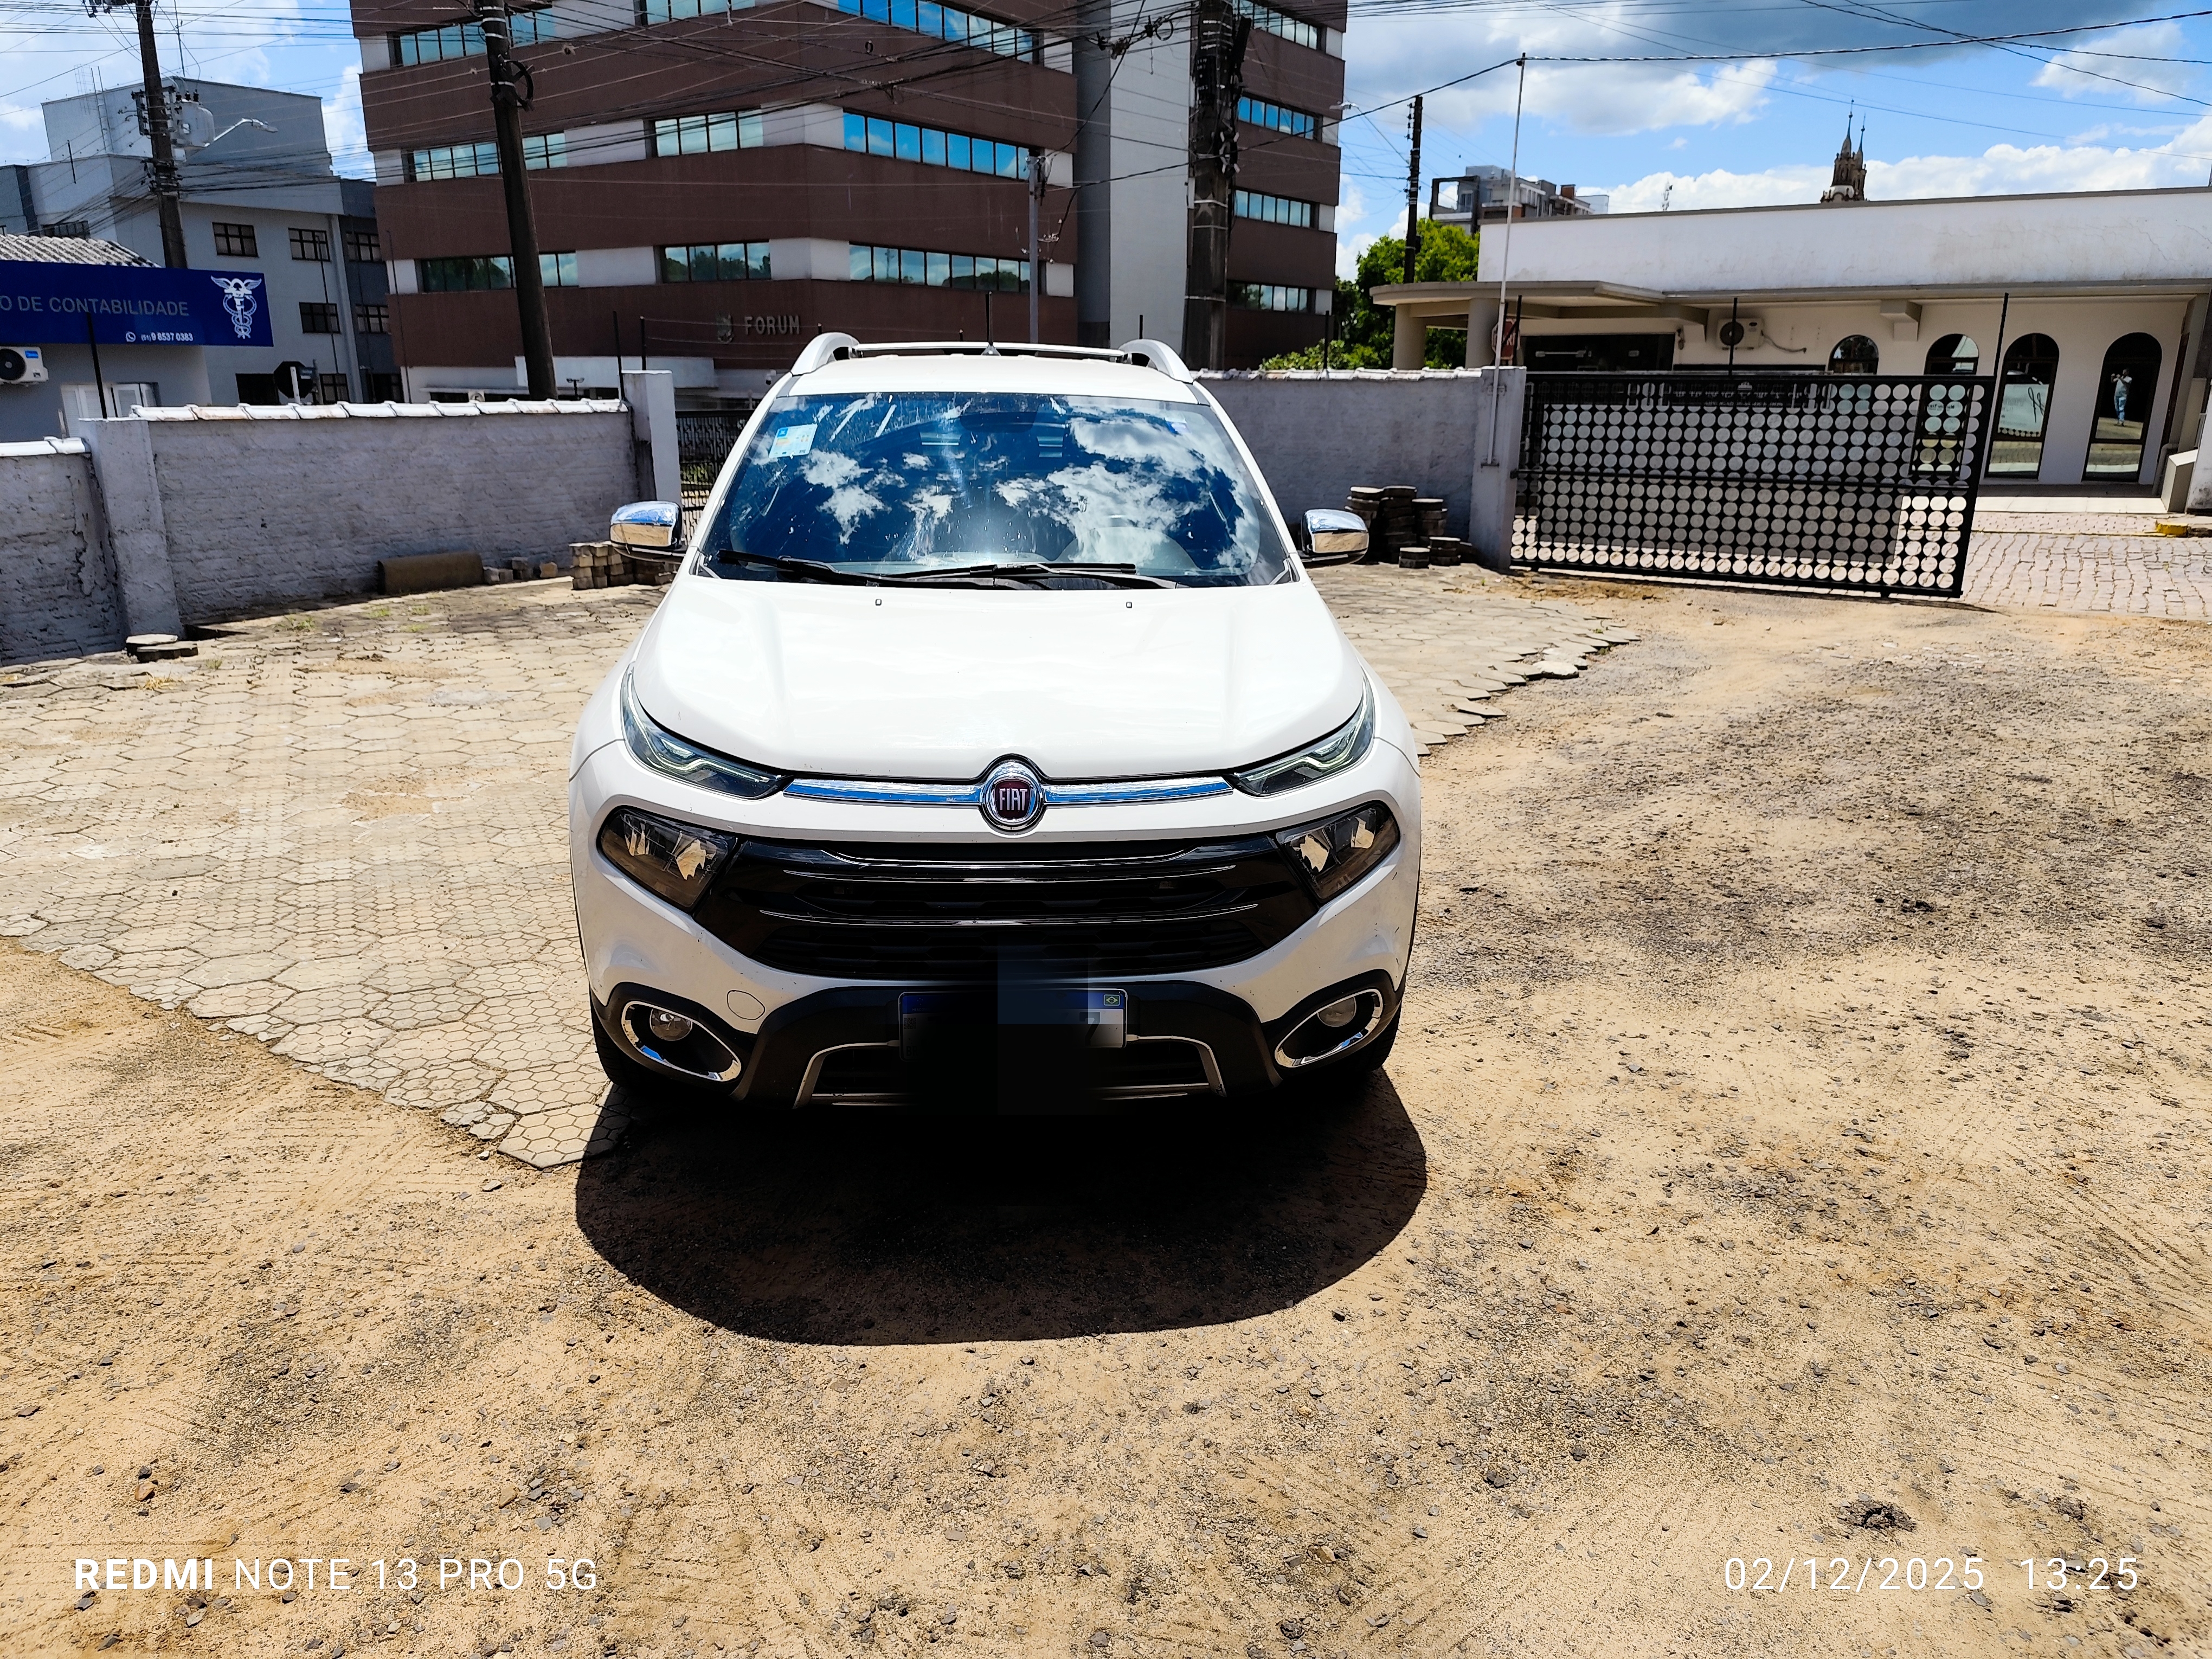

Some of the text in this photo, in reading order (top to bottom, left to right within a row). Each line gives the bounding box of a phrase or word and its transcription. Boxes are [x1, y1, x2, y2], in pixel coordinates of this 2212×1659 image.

[18, 296, 43, 312] DE
[49, 297, 190, 316] CONTABILIDADE
[744, 315, 800, 335] FORUM
[157, 332, 174, 341] 8537
[999, 788, 1028, 811] FIAT
